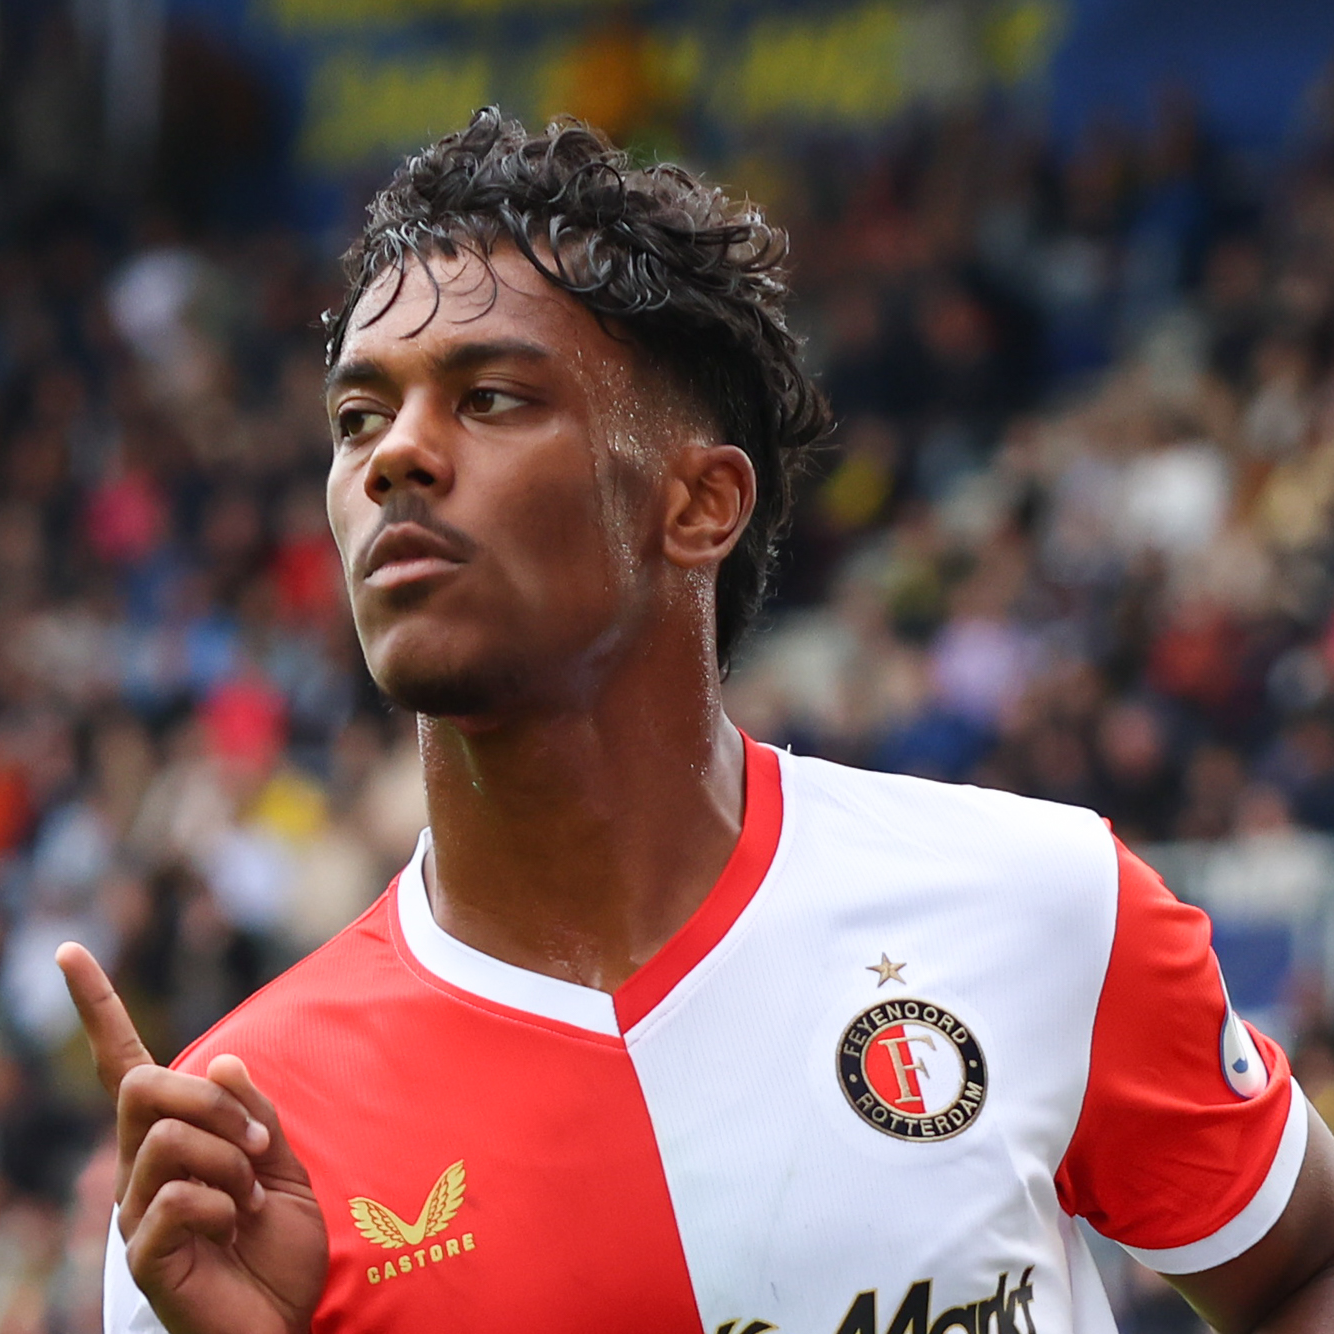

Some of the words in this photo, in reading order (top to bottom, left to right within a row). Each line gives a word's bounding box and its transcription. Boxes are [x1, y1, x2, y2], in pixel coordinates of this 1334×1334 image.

[844, 1002, 969, 1057] FEYENOORD
[877, 1034, 937, 1104] F
[856, 1081, 983, 1136] ROTTERDAM
[367, 1232, 476, 1284] CASTORE
